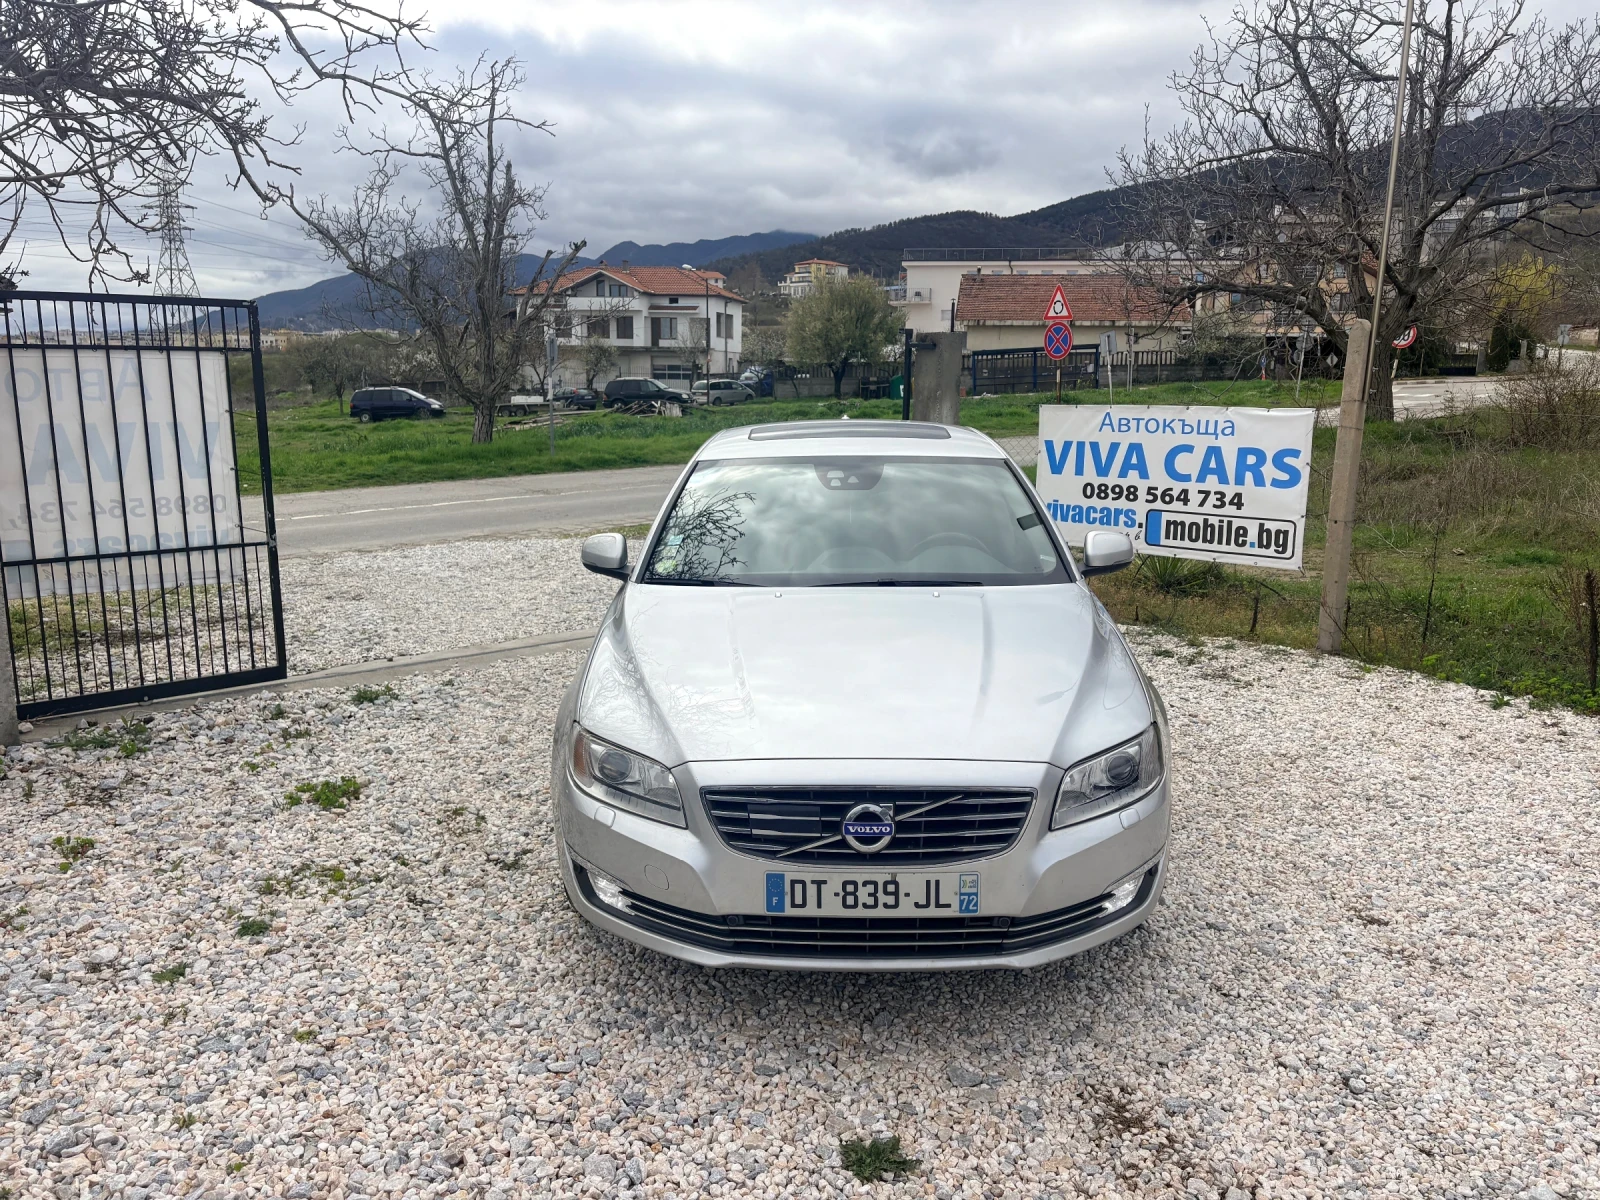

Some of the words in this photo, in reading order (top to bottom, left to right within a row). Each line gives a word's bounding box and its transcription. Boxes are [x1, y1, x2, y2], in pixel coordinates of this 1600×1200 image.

[1098, 411, 1235, 441] Автокъща
[1044, 439, 1150, 480] VIVA
[1164, 443, 1302, 490] CARS
[1082, 482, 1139, 502] 0898
[1145, 486, 1191, 507] 564
[1197, 490, 1245, 510] 734
[1164, 517, 1290, 555] mobile.bg
[846, 825, 891, 834] VOLVO
[772, 896, 779, 907] F
[789, 879, 952, 910] DT-839-JL
[960, 895, 978, 910] 72
